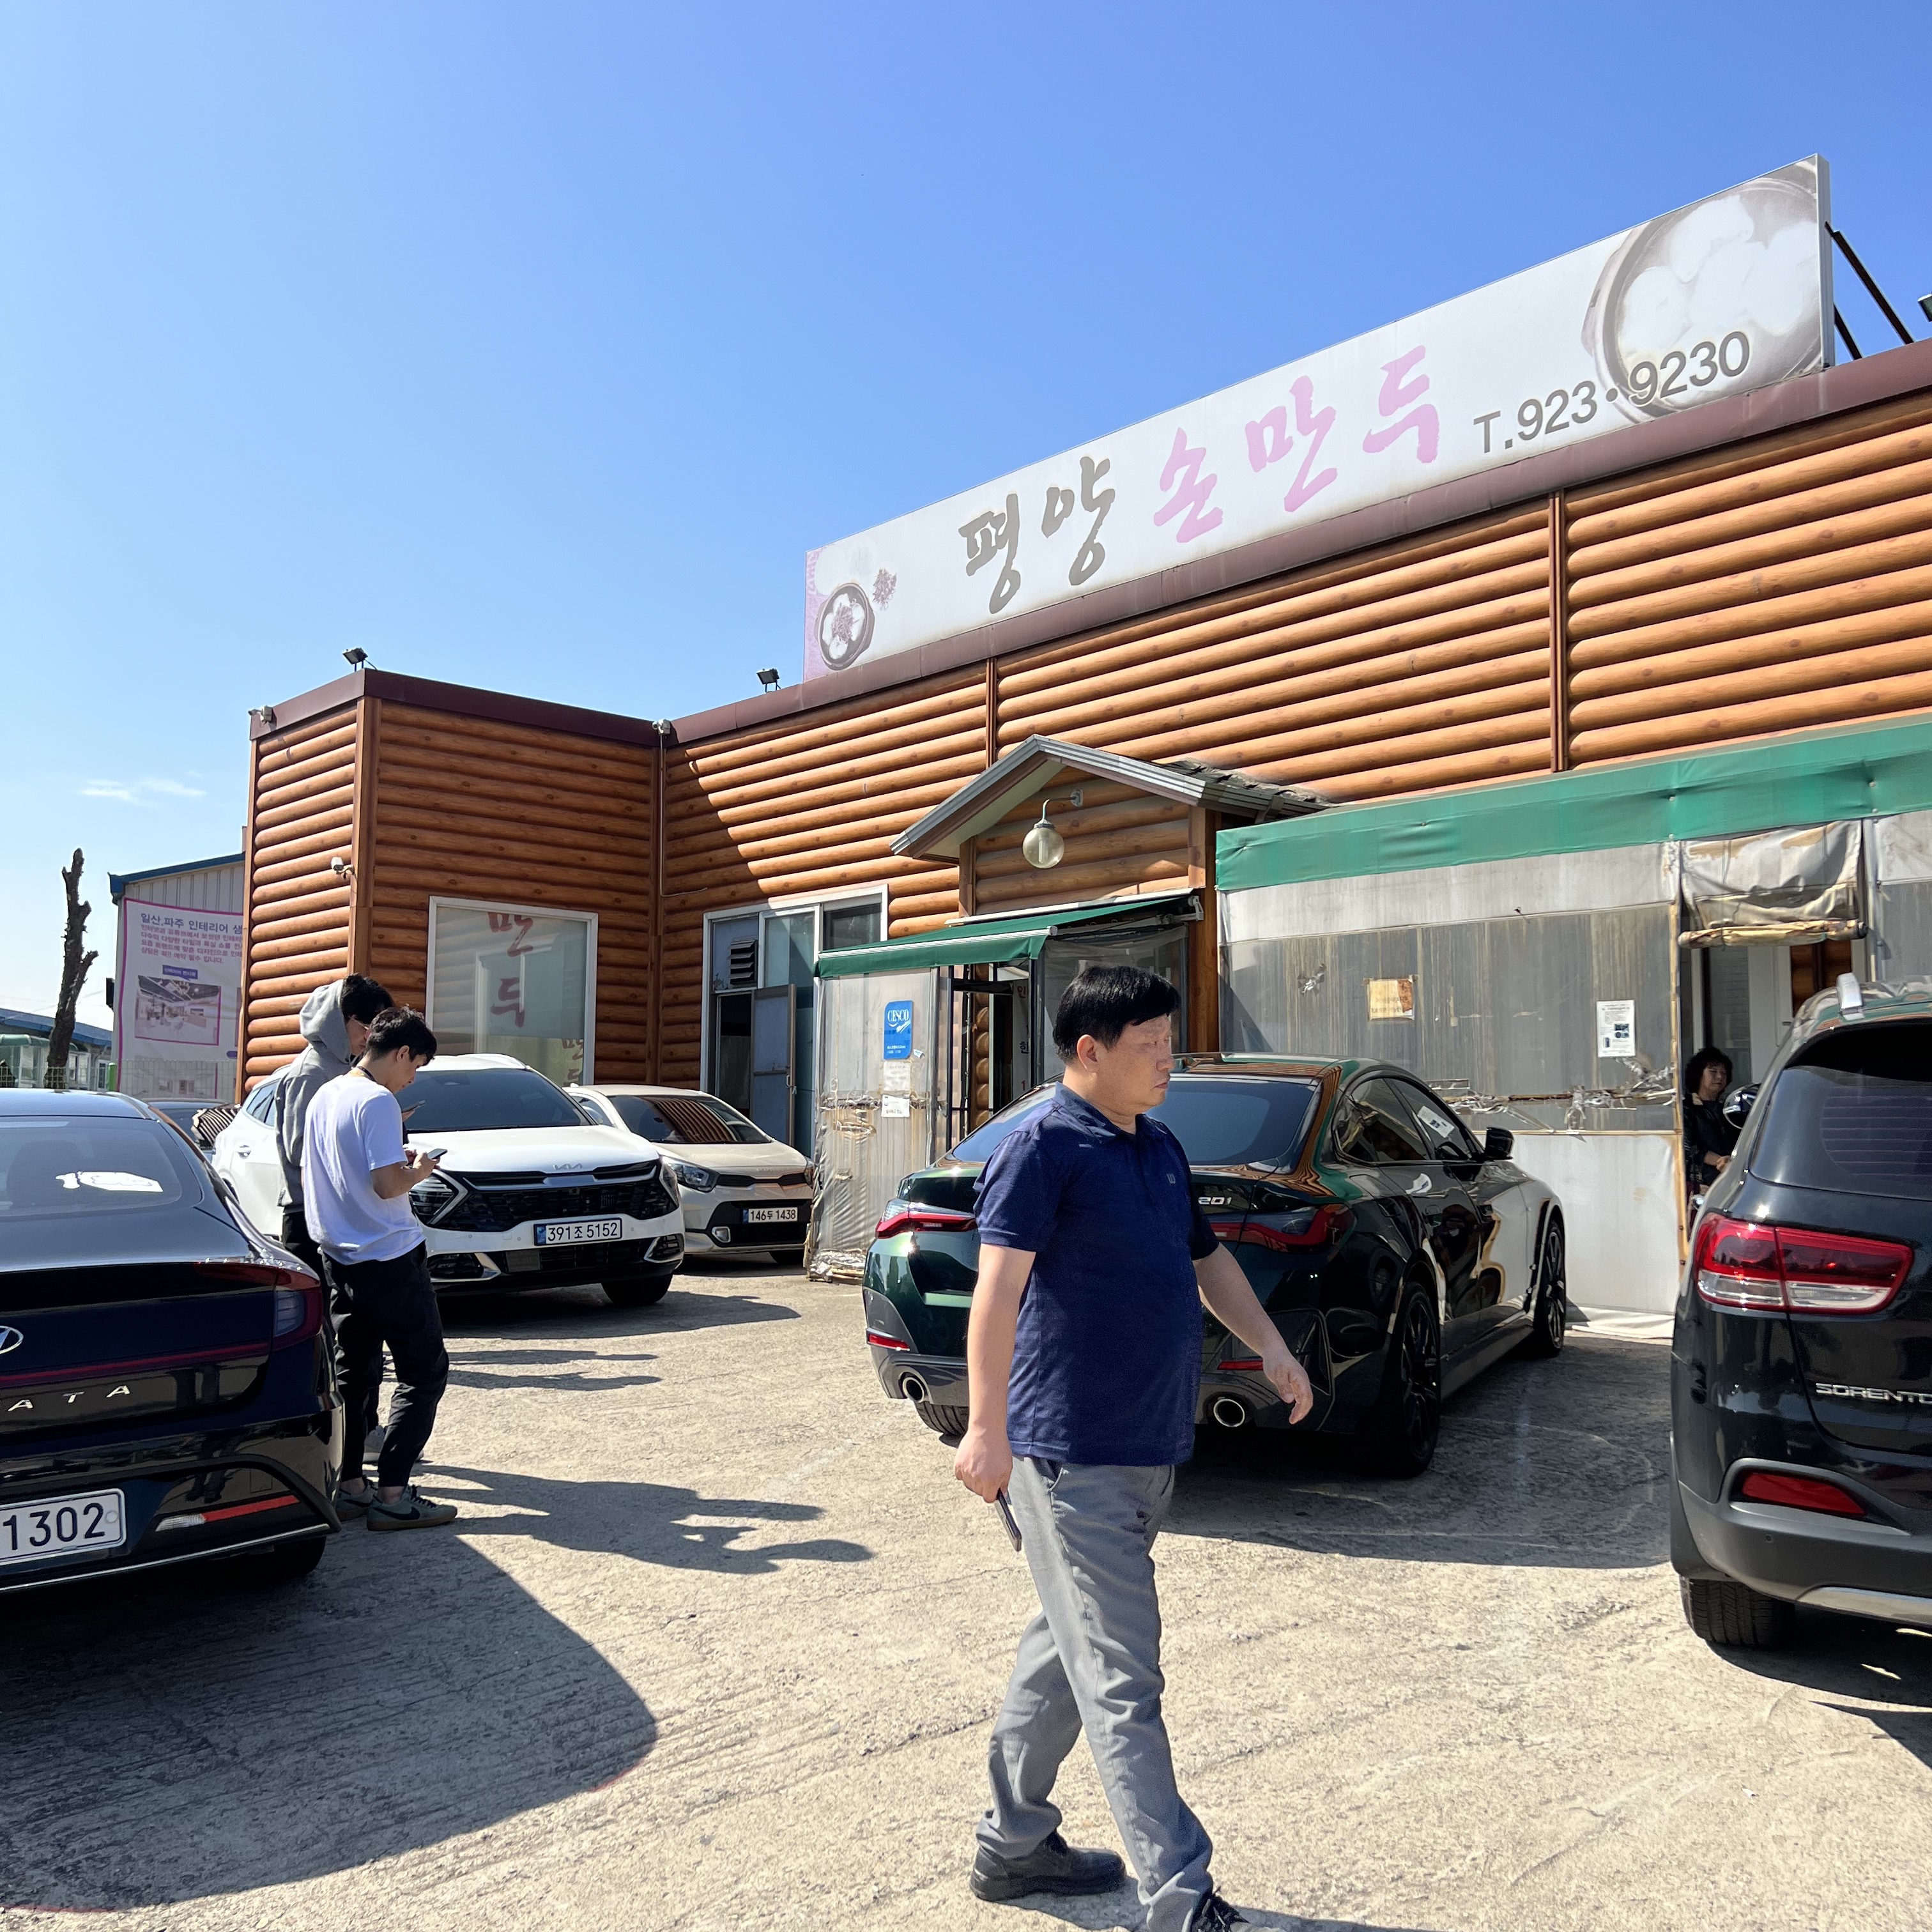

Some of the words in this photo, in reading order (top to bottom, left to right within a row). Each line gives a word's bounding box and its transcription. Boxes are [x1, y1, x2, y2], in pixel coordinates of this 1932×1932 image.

[958, 456, 1116, 615] 평양
[1153, 345, 1439, 544] 손만두
[188, 921, 228, 933] 인테리어
[887, 1009, 909, 1022] CESCO
[776, 1208, 797, 1220] 1438
[548, 1224, 583, 1242] 391조
[586, 1222, 618, 1239] 5152
[3, 1502, 105, 1551] 1302
